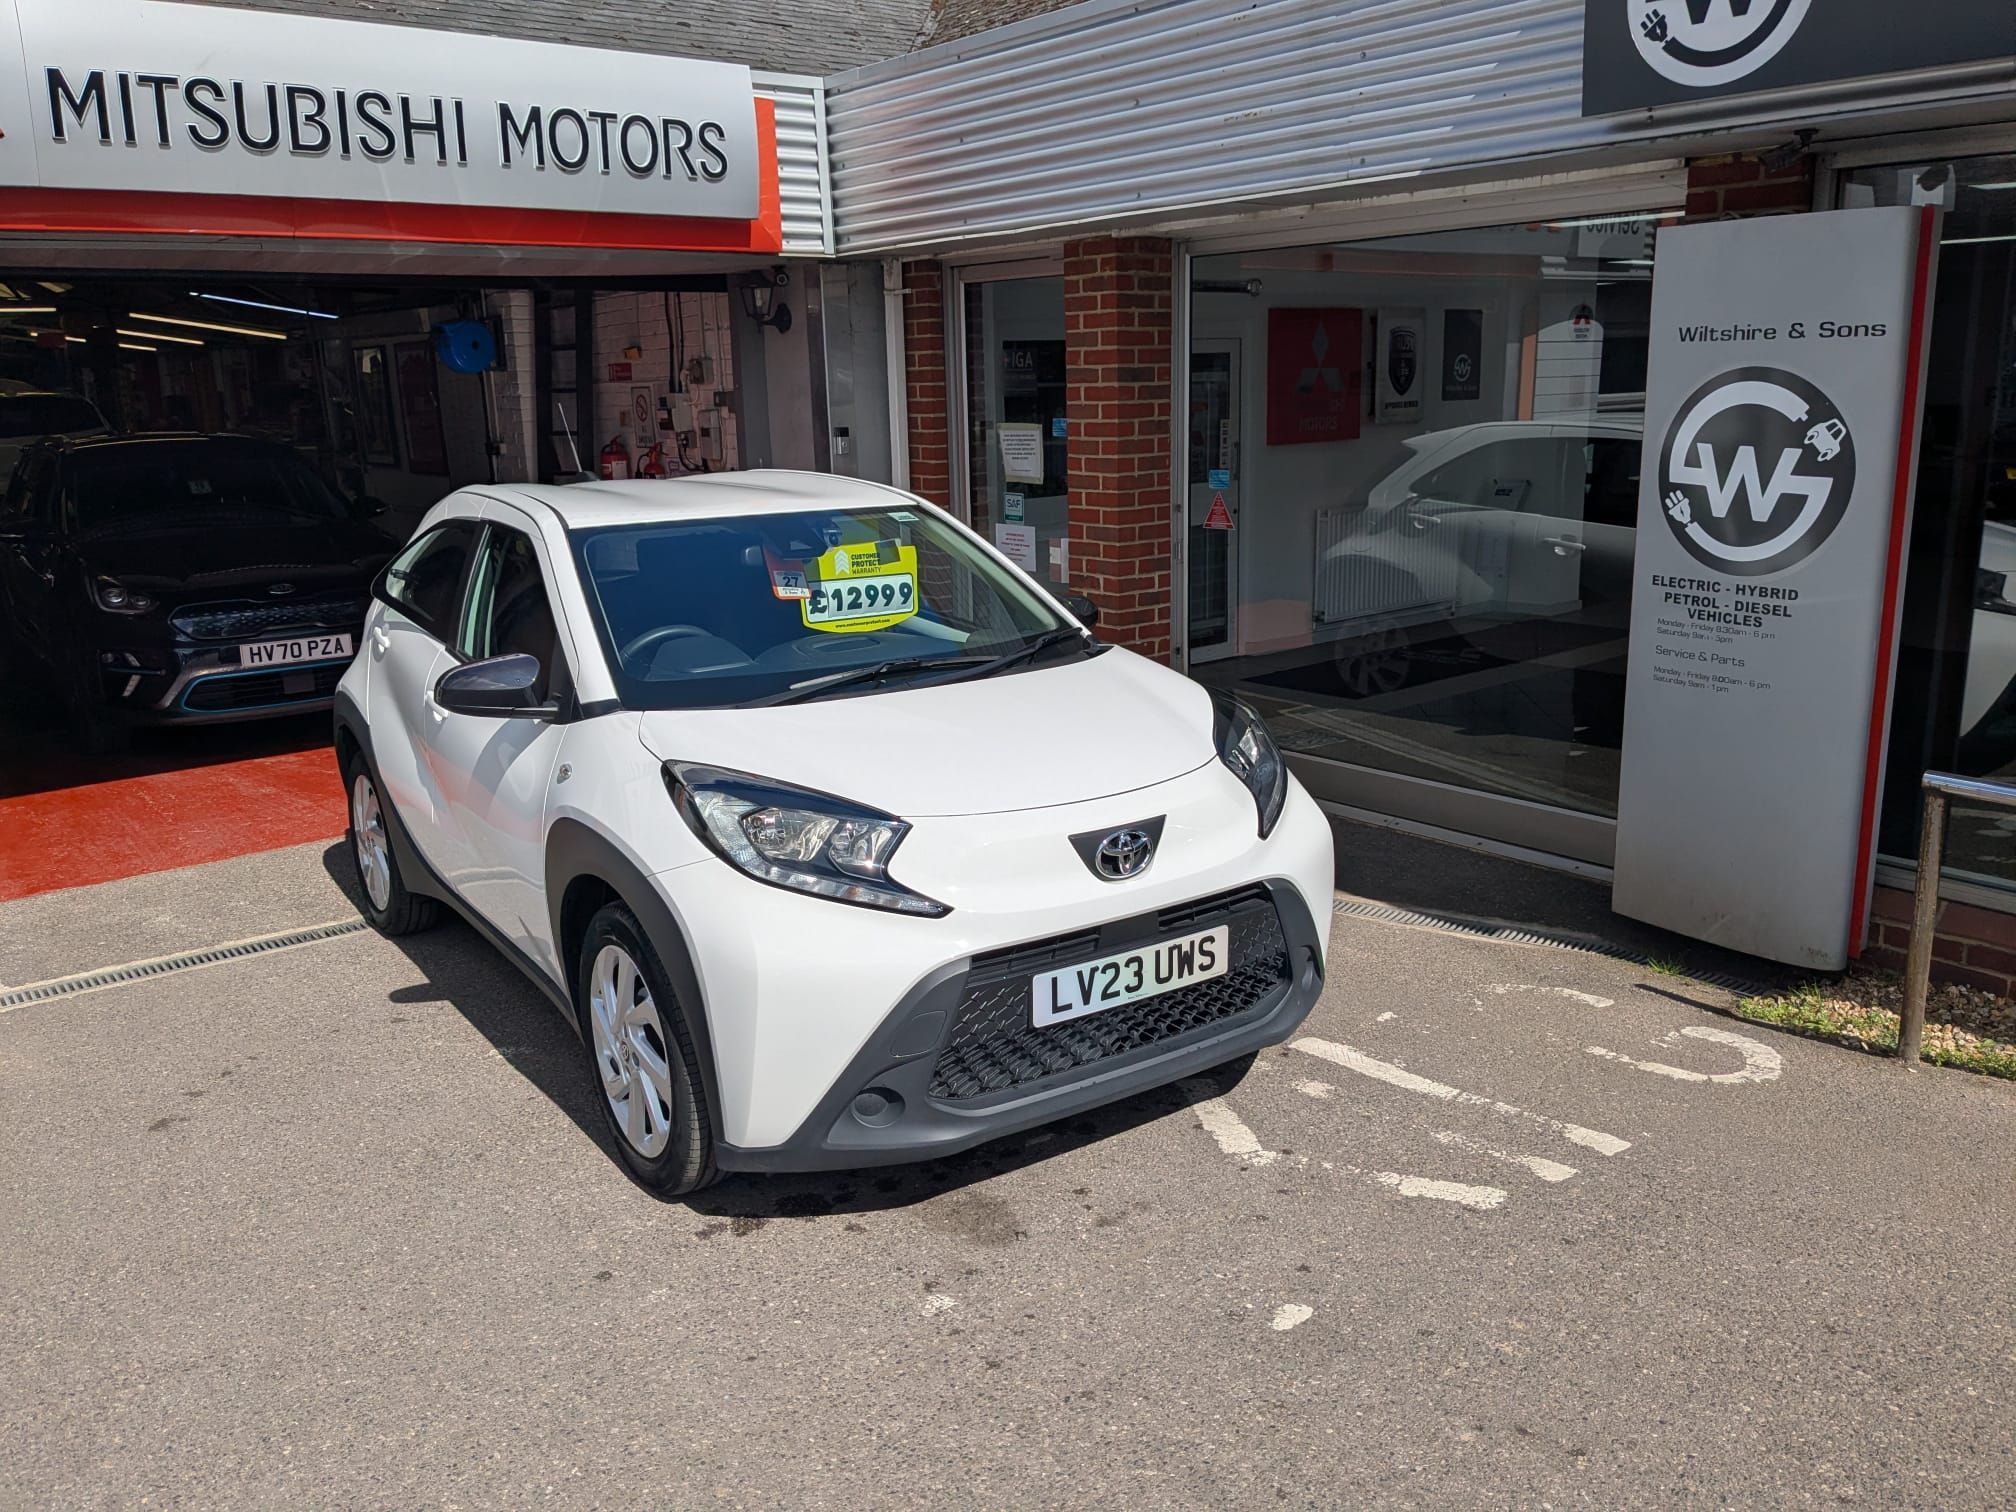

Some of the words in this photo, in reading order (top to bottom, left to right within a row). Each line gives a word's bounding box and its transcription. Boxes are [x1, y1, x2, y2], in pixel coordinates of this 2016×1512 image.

[44, 66, 468, 165] MITSUBISHI
[495, 101, 729, 181] MOTORS
[1679, 324, 1777, 342] Wiltshire
[1788, 322, 1806, 339] &
[1818, 321, 1887, 338] Sons
[851, 559, 881, 568] PROTECT
[809, 581, 912, 615] £12999
[1652, 575, 1721, 593] ELECTRIC
[1735, 583, 1799, 601] HYBRID
[1664, 591, 1720, 609] PETROL
[1734, 600, 1793, 618] DIESEL
[1657, 618, 1686, 629] Monday
[1690, 622, 1714, 633] Friday
[1687, 607, 1763, 628] VEHICLES
[1656, 626, 1690, 640] Saturday
[249, 642, 302, 664] HV70
[307, 638, 345, 657] PZA
[1655, 644, 1696, 660] Service
[1698, 651, 1708, 662] &
[1711, 653, 1745, 667] Parts
[1652, 673, 1687, 688] Saturday
[1653, 665, 1682, 678] Monday
[1686, 670, 1710, 682] Friday
[1051, 955, 1144, 1015] LV23
[1154, 935, 1216, 985] UWS
